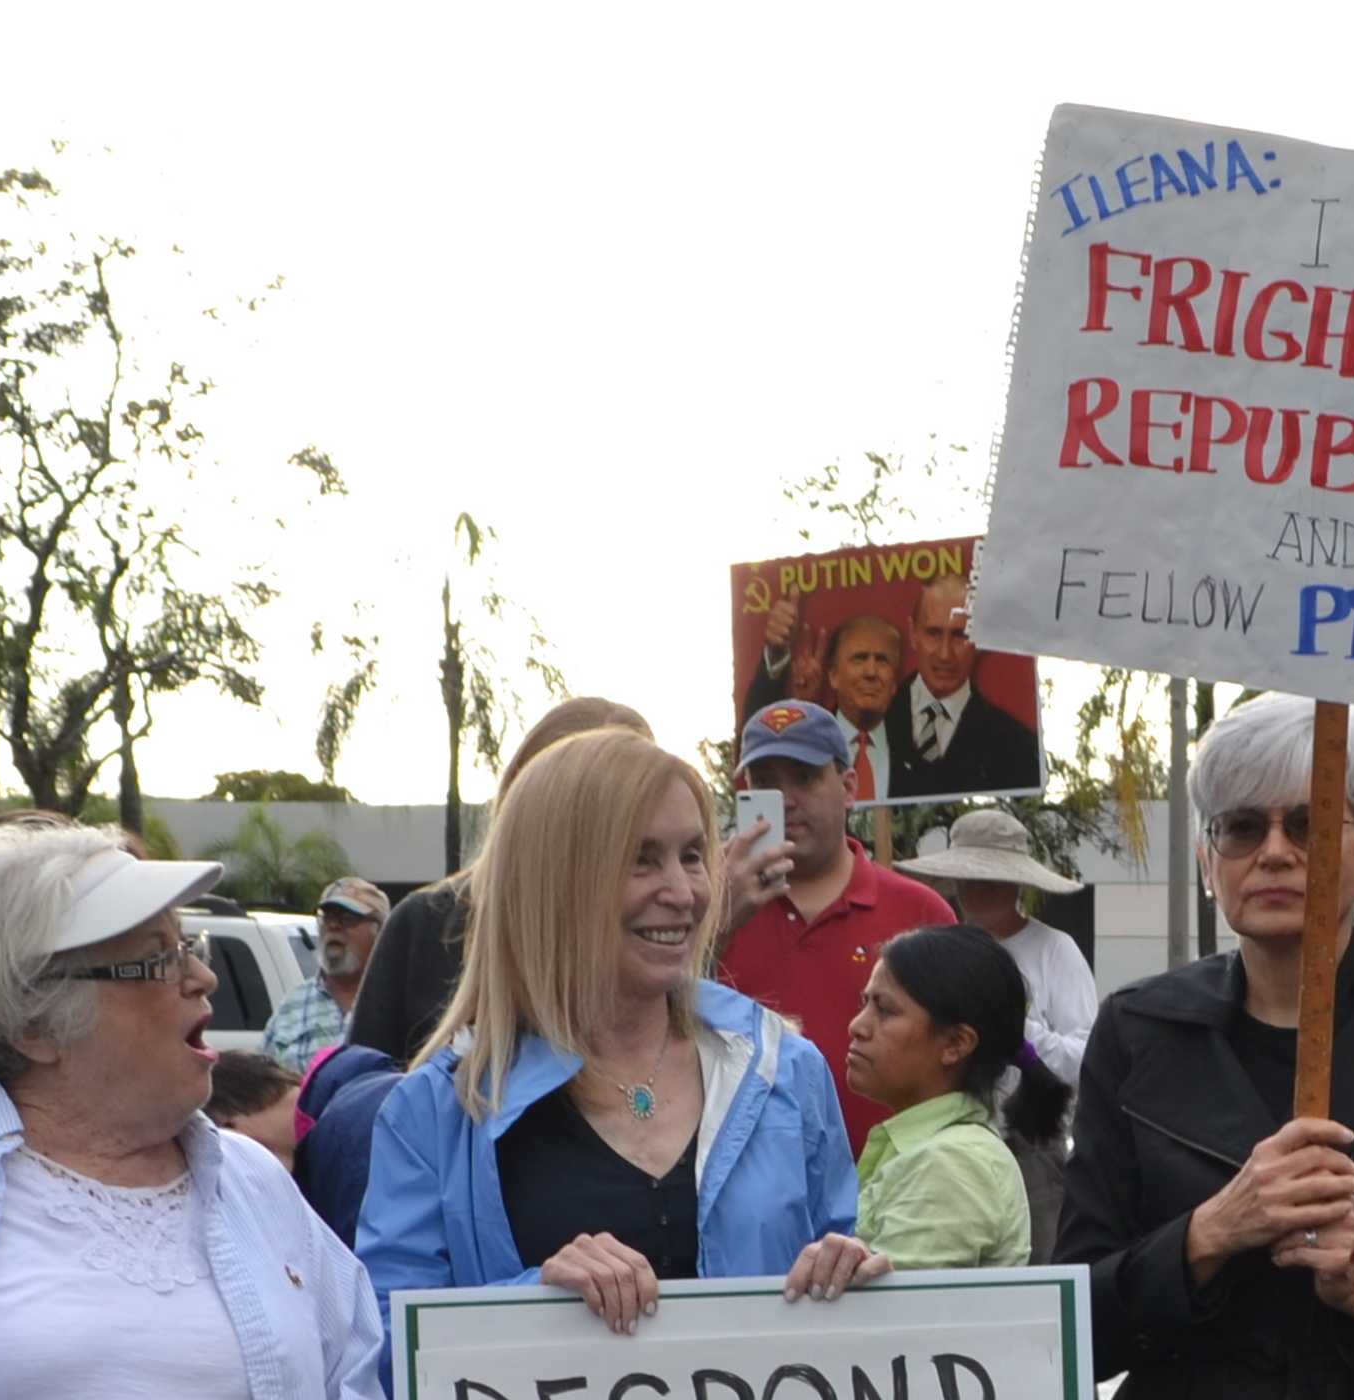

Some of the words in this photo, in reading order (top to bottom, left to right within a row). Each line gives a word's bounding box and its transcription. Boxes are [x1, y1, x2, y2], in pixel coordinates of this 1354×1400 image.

[1049, 138, 1282, 238] ILEANA:
[1300, 198, 1341, 269] I
[780, 555, 872, 594] PUTIN
[877, 545, 963, 582] WON
[1054, 546, 1268, 636] FELLOW
